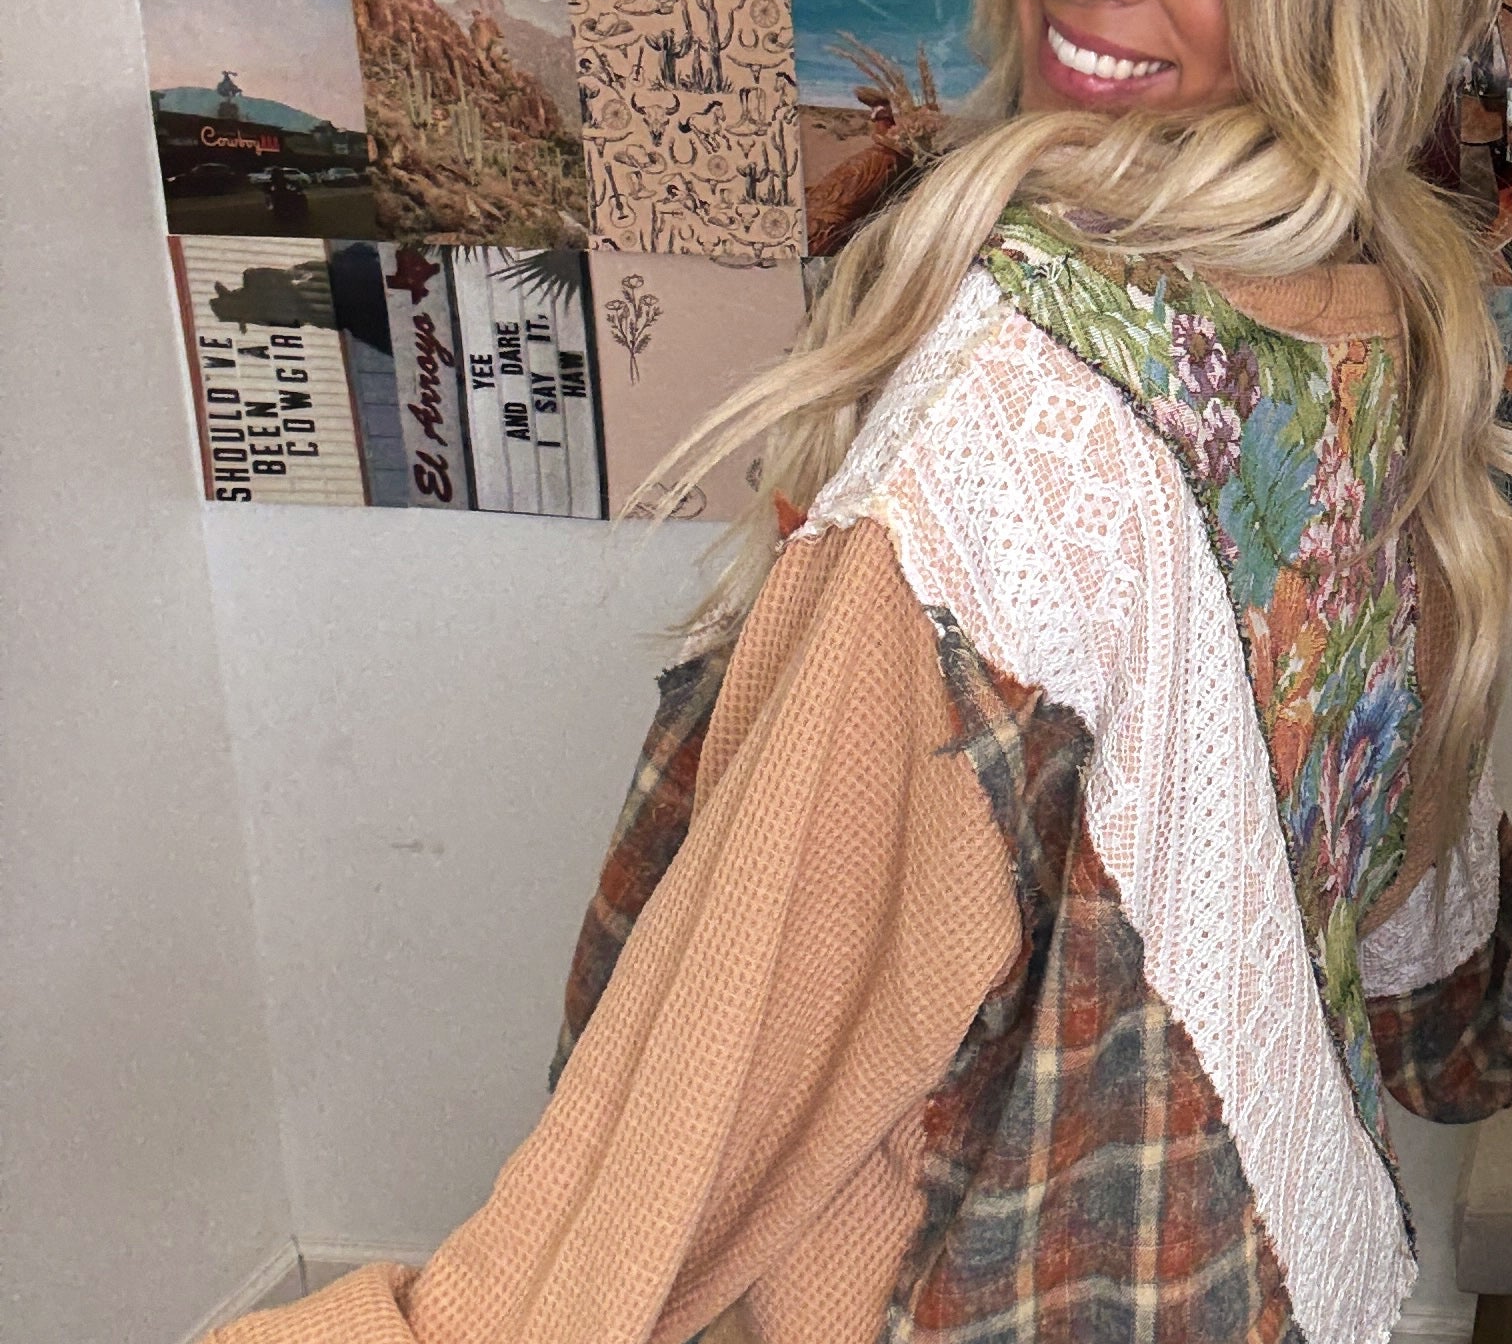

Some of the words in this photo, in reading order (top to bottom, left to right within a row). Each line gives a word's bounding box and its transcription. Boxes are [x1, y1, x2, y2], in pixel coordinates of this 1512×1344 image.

[498, 321, 524, 375] DARE
[526, 314, 551, 342] IT,
[237, 345, 271, 360] A
[470, 353, 495, 390] YEE
[407, 312, 455, 447] Arroyo
[531, 372, 557, 413] SAY
[559, 351, 587, 398] HAW
[244, 401, 287, 475] BEEN
[504, 402, 531, 441] AND
[537, 440, 561, 448] I
[413, 450, 453, 503] El
